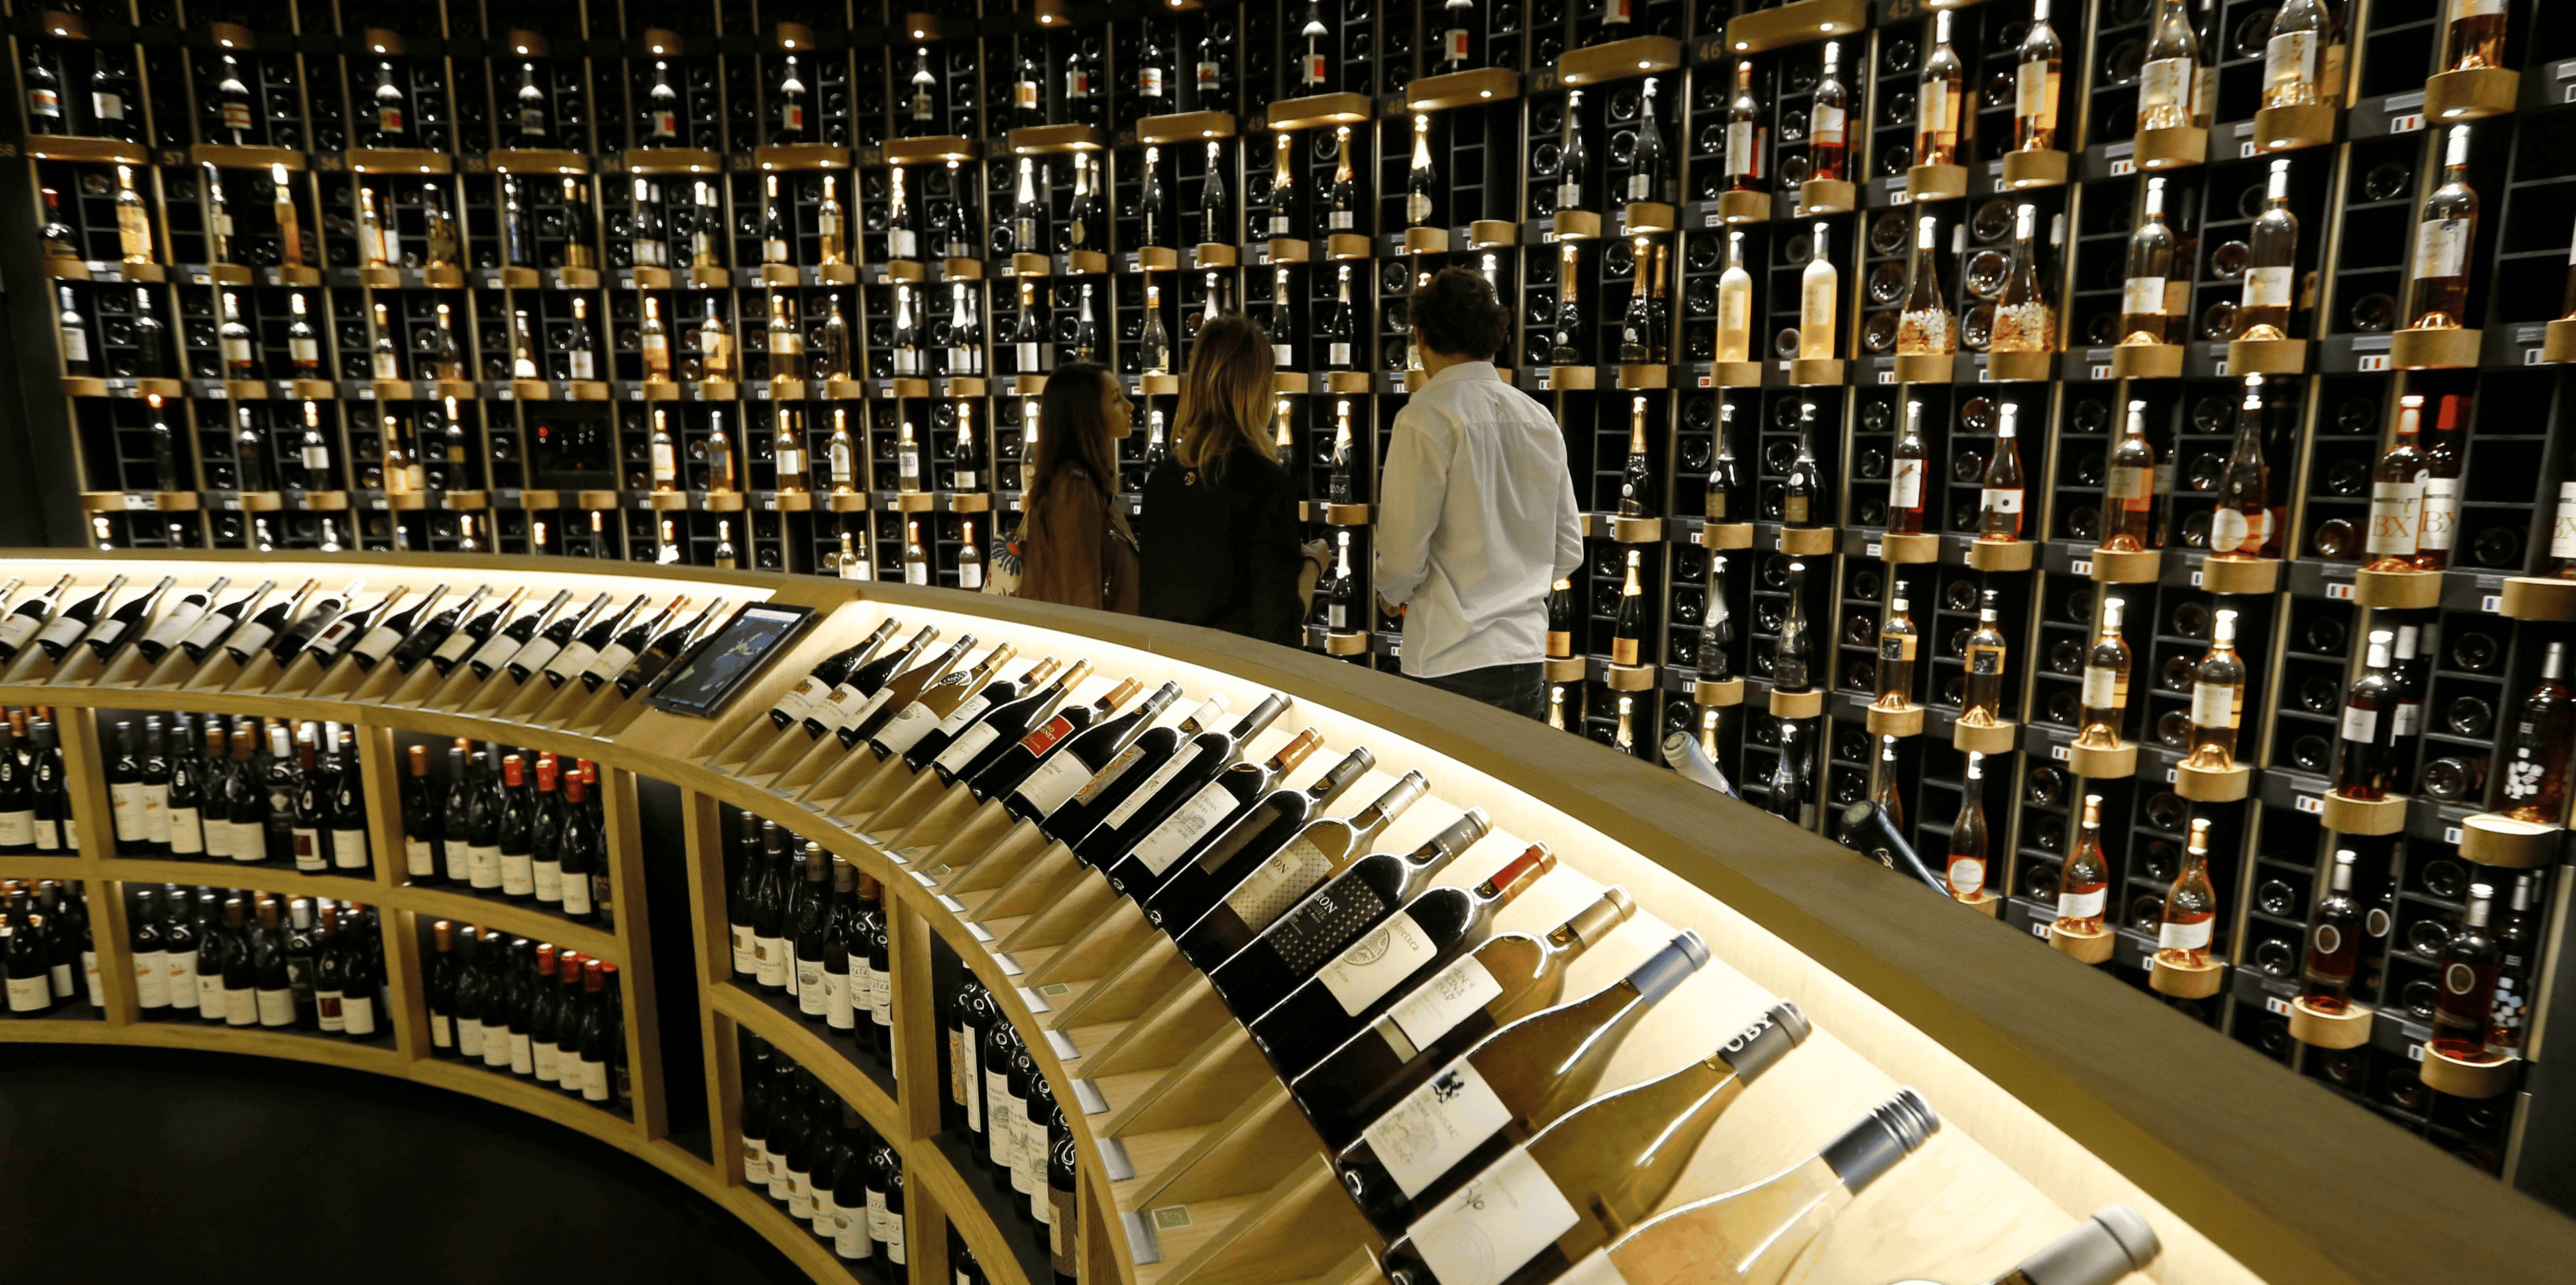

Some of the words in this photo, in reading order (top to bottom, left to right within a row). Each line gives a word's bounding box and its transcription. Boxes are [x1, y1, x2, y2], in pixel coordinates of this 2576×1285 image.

[1699, 40, 1721, 60] 46
[1534, 72, 1554, 91] 47
[1388, 99, 1405, 115] 48
[1248, 117, 1265, 132] 49
[1119, 132, 1135, 146] 50
[163, 151, 184, 166] 57
[321, 155, 341, 170] 56
[466, 158, 486, 172] 55
[603, 158, 620, 172] 54
[734, 156, 752, 170] 53
[863, 151, 881, 164] 52
[2373, 514, 2414, 537] BX
[1723, 1010, 1775, 1053] UBY
